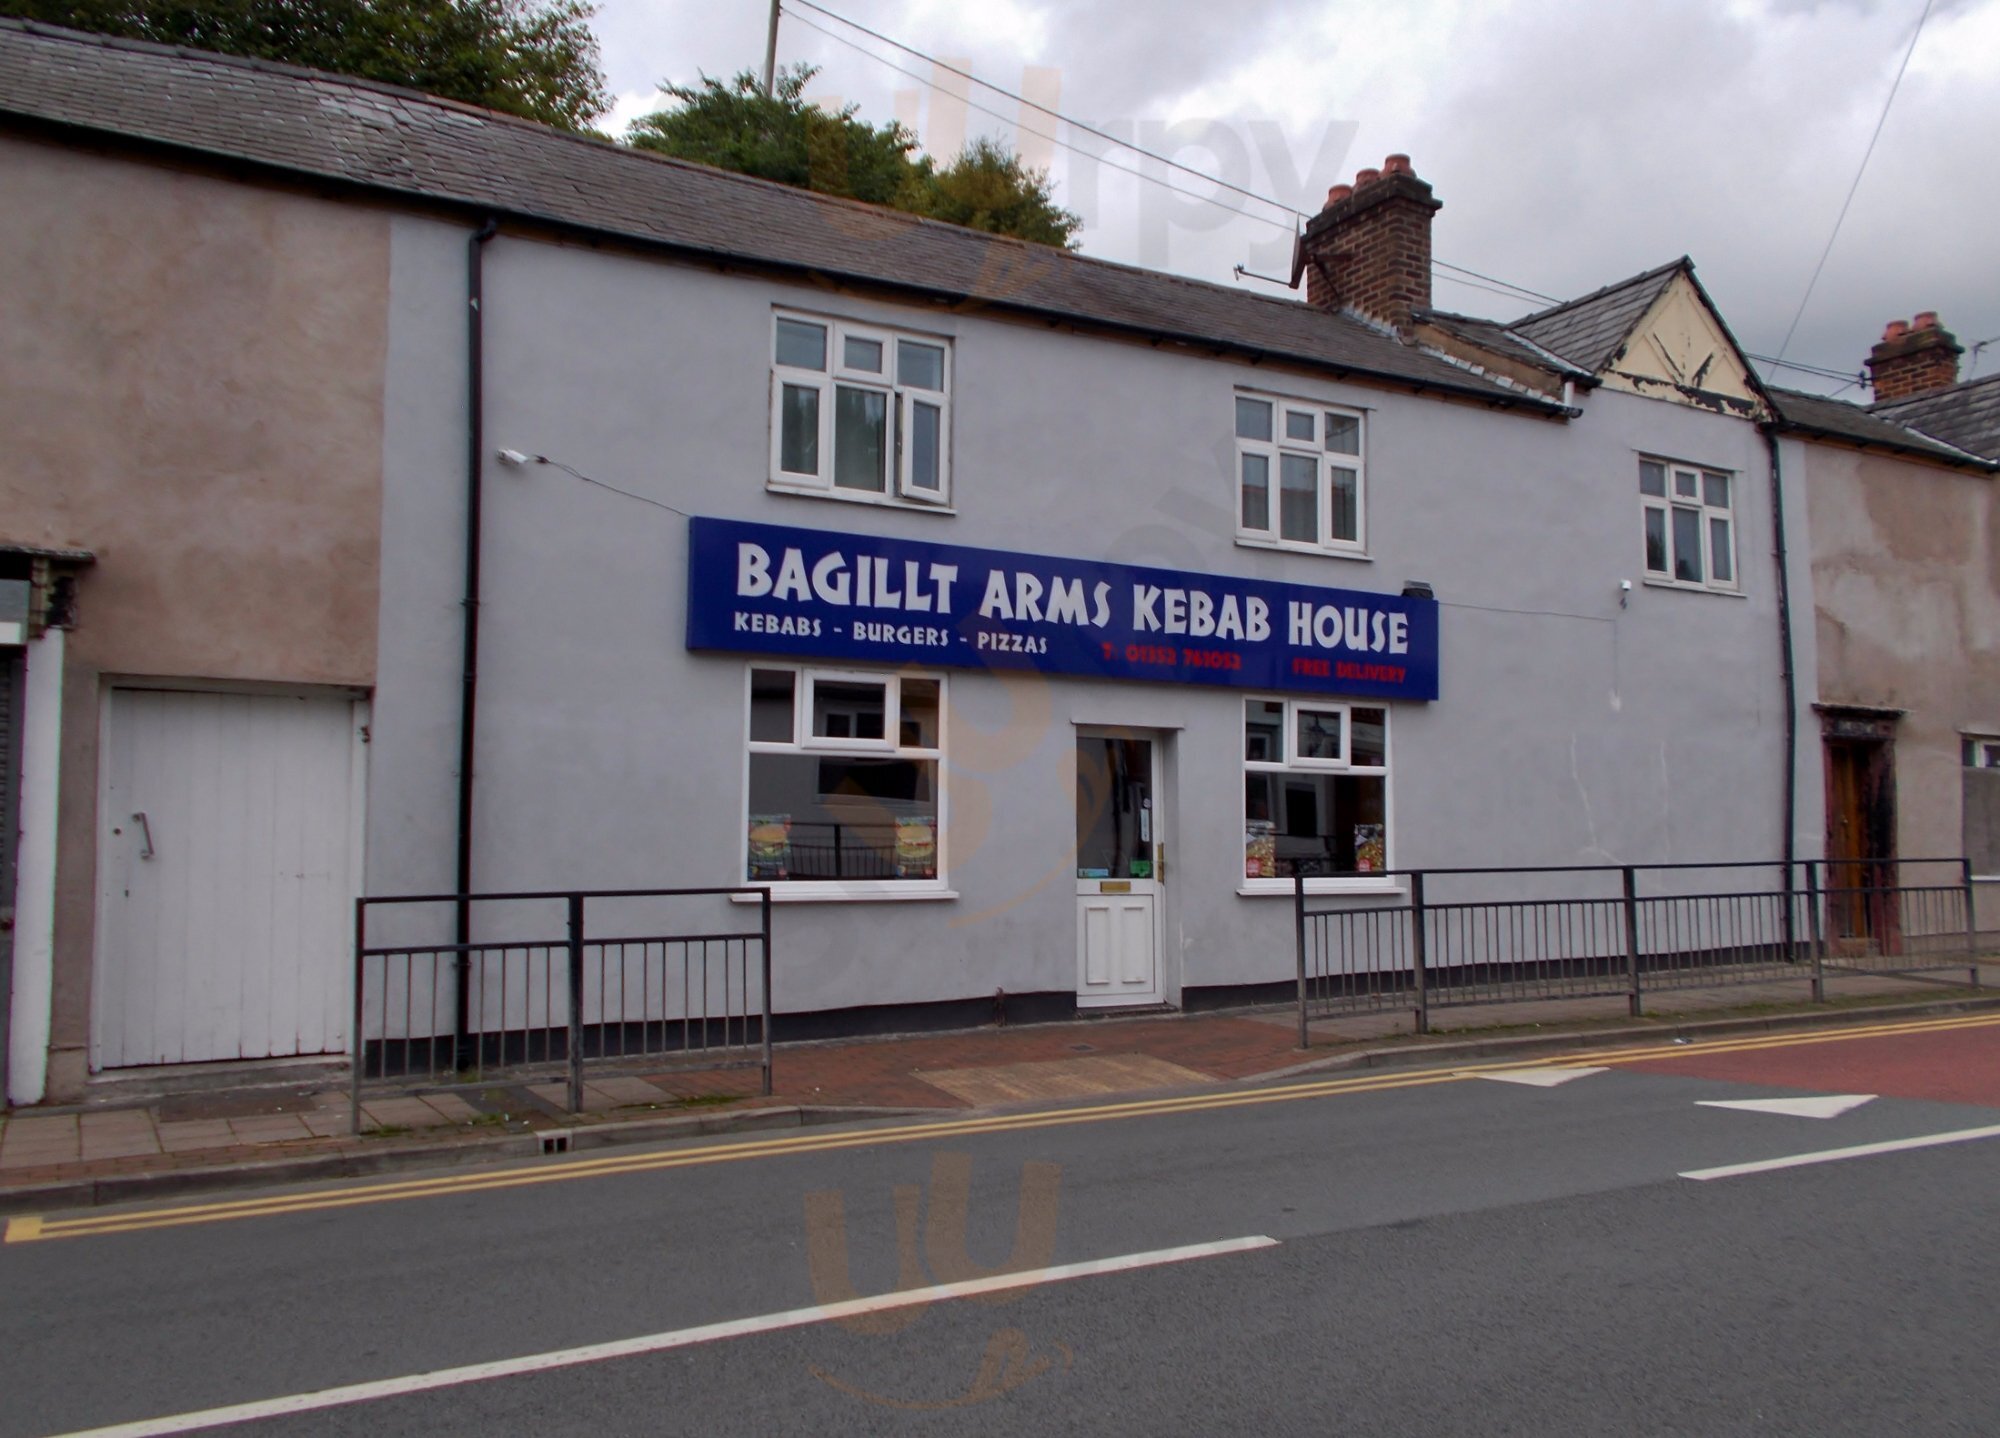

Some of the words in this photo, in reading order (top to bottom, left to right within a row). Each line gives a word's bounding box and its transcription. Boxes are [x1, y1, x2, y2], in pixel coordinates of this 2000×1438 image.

[736, 542, 958, 614] BAGILLT
[978, 569, 1112, 628] ARMS
[1133, 584, 1271, 642] KEBAB
[1288, 601, 1409, 654] HOUSE
[734, 612, 822, 638] KEBABS
[853, 621, 949, 647] BURGERS
[977, 631, 1047, 654] PIZZAS
[1293, 658, 1330, 677] FREE
[1336, 662, 1405, 683] DELIVERY
